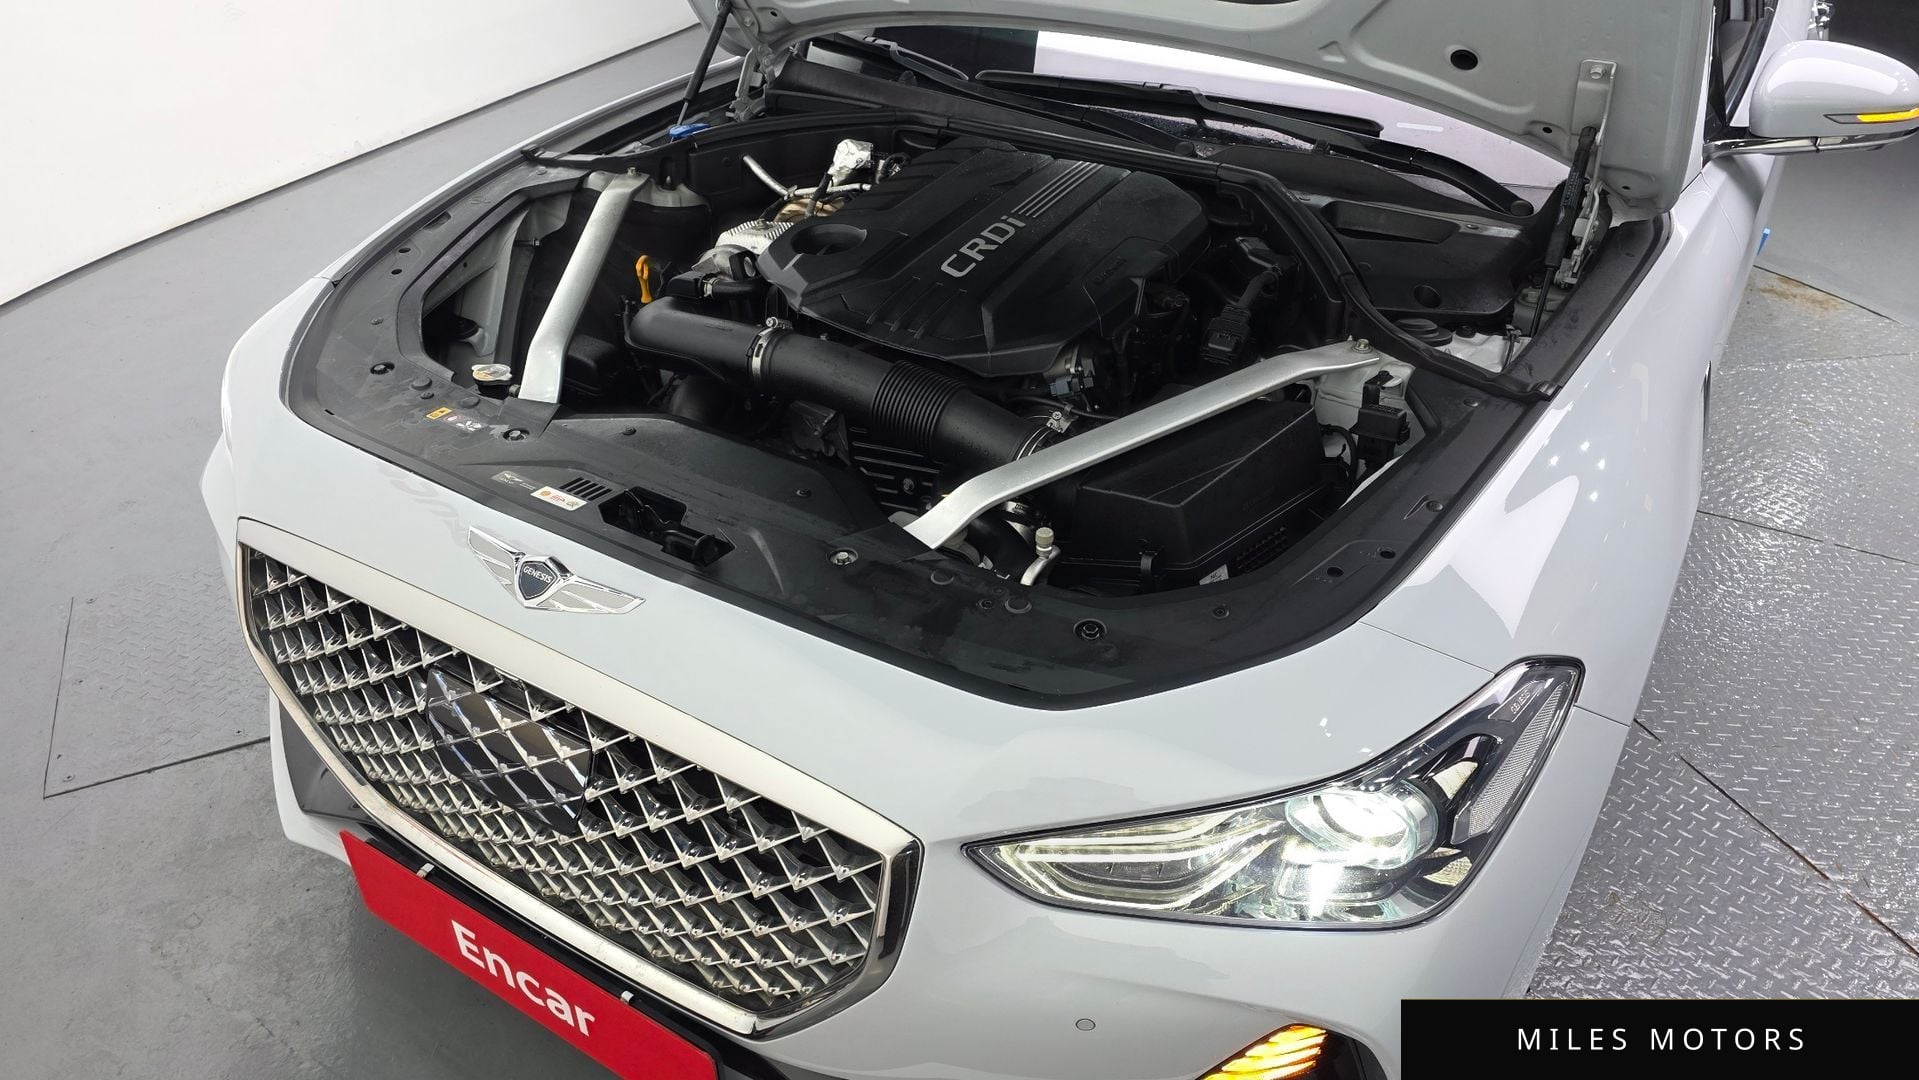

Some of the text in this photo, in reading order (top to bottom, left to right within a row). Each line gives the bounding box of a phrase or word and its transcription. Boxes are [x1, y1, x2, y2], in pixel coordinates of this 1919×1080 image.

[940, 215, 1026, 278] CRDi
[523, 565, 553, 584] GENESIS
[451, 919, 596, 1037] Encar
